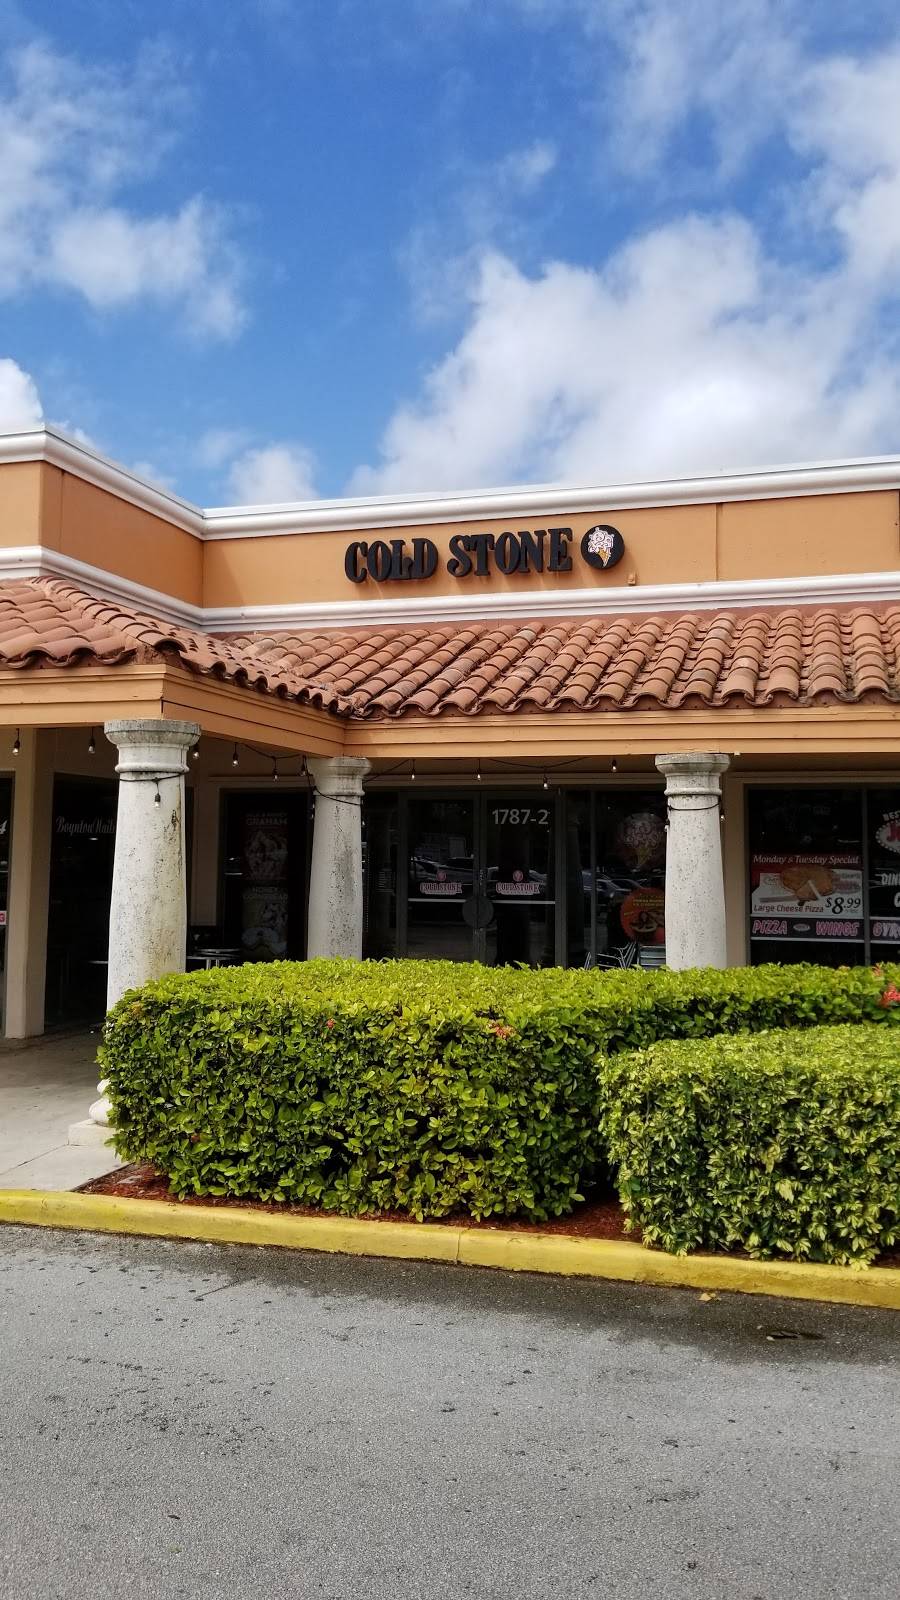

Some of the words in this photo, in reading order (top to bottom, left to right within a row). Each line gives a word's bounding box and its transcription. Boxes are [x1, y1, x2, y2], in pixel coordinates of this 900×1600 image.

[344, 538, 439, 583] COLD
[446, 527, 573, 577] STONE
[492, 809, 549, 825] 1787-2
[753, 855, 787, 864] Monday
[795, 855, 828, 864] Tuesday
[828, 855, 859, 864] Special
[753, 905, 775, 913] Large
[776, 904, 803, 913] Cheese
[804, 905, 824, 913] Pizza
[825, 897, 861, 914] $8.99
[752, 919, 788, 934] PIZZA
[815, 921, 860, 937] WINGS
